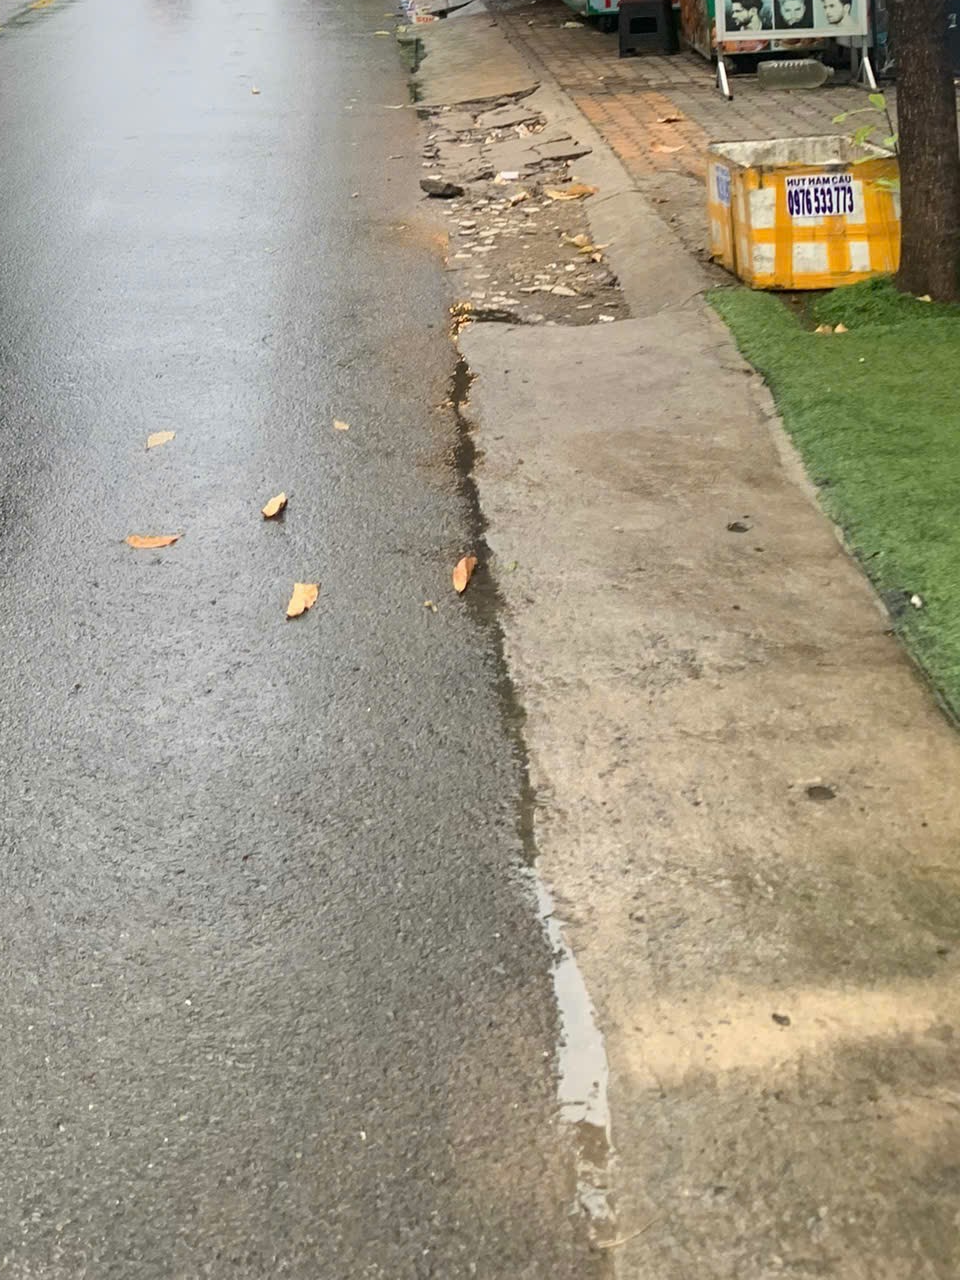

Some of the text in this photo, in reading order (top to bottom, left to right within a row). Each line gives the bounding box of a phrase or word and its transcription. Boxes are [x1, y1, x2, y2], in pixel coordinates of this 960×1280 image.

[788, 186, 854, 216] 0976 533 773
